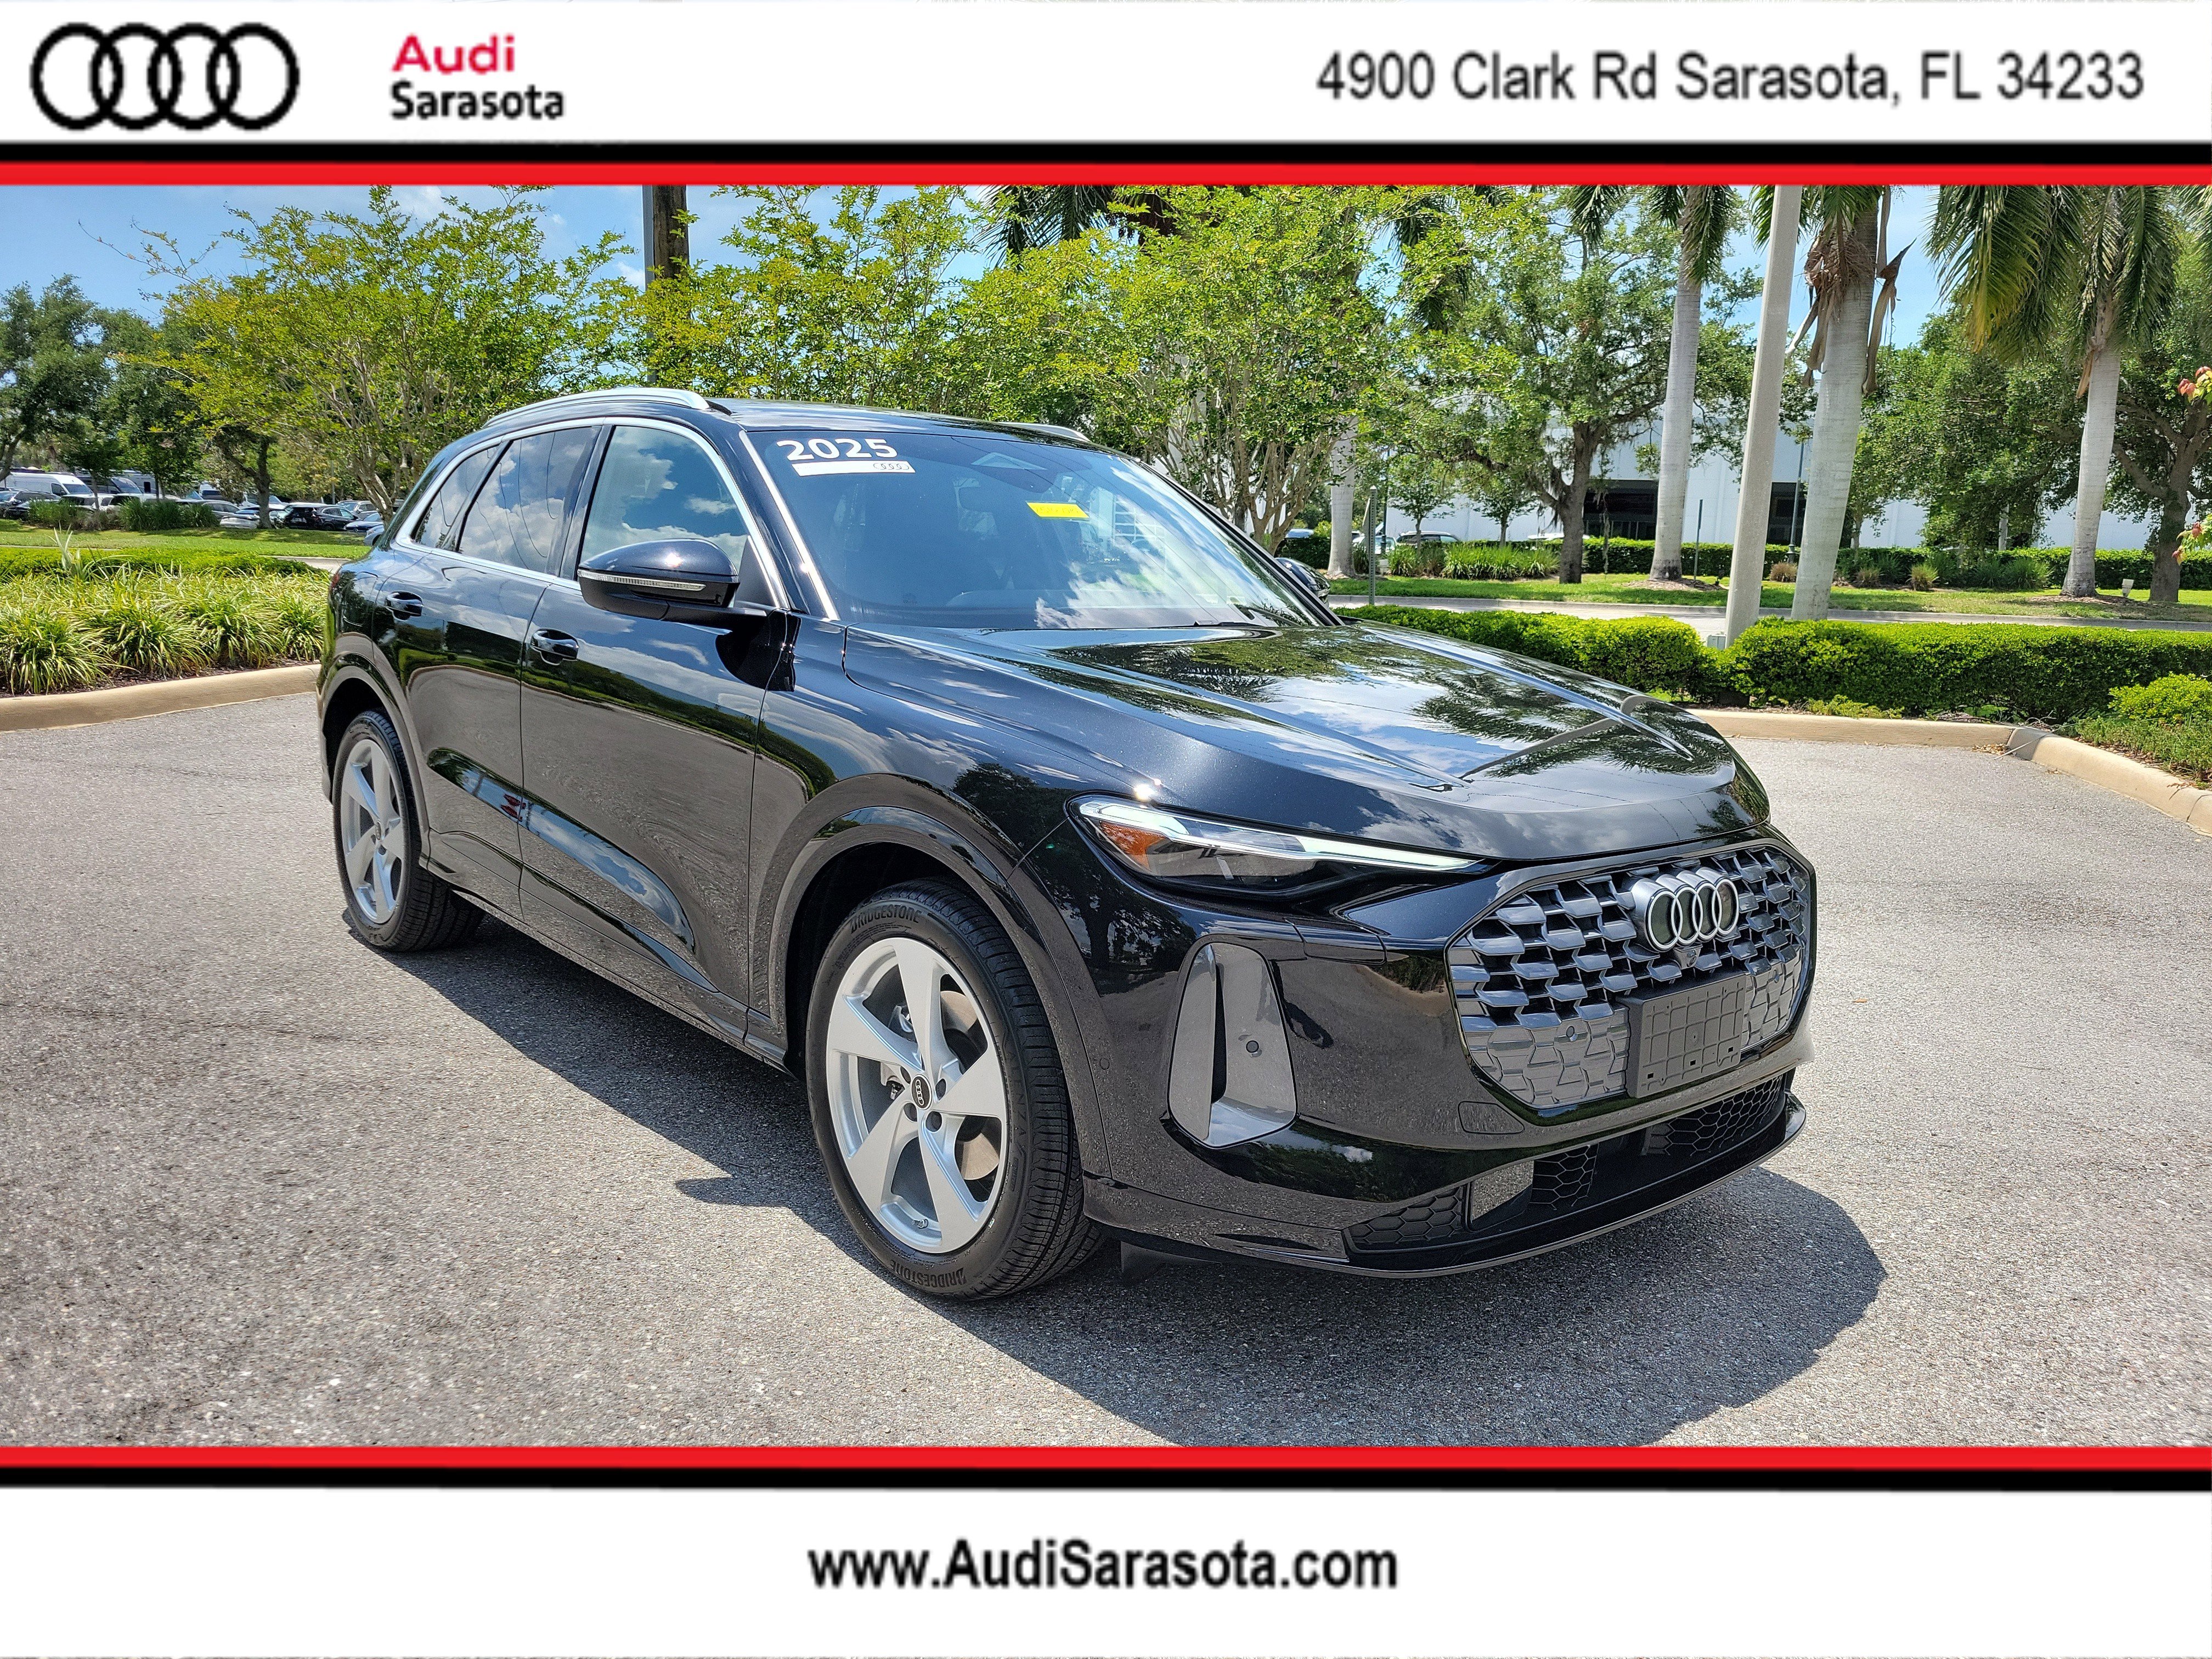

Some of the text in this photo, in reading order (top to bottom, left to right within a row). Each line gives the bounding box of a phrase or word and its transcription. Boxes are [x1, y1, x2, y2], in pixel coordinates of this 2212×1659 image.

[776, 438, 898, 461] 2025
[851, 904, 922, 934] BRIDGESTONE
[890, 1260, 967, 1288] BRIDGESTONE
